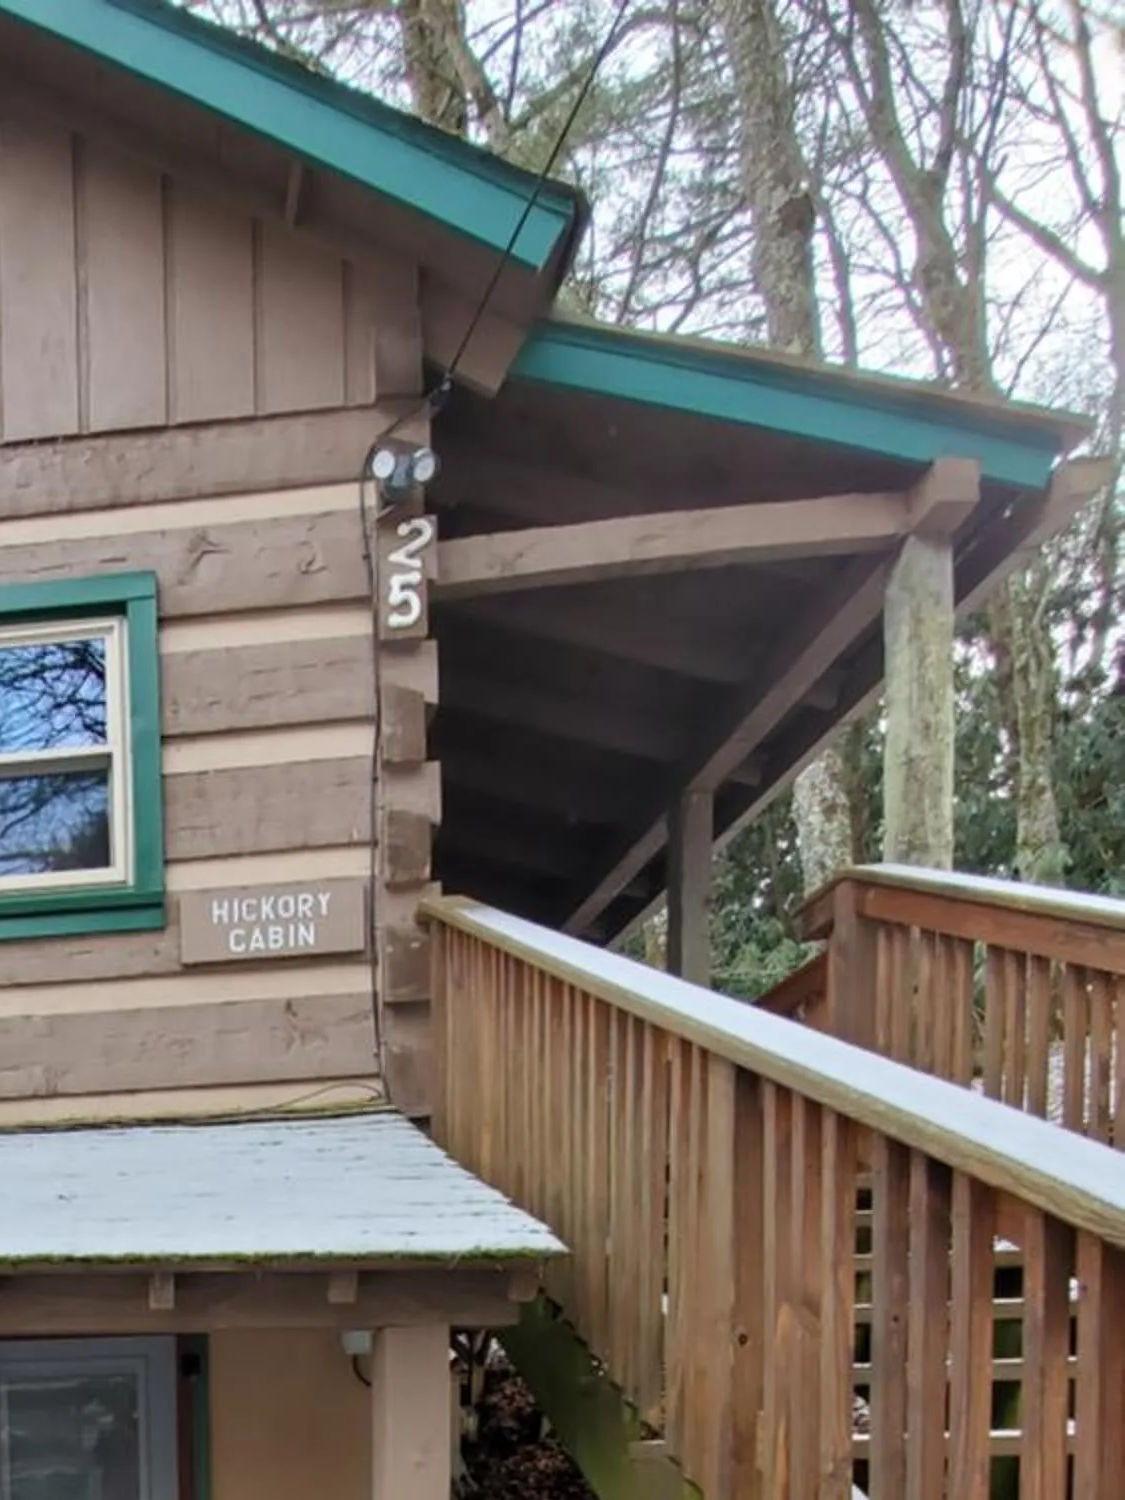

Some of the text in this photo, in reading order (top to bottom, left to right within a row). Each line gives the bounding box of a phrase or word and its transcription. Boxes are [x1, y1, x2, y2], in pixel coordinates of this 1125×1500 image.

[387, 518, 432, 628] 25
[211, 892, 332, 925] HICKORY
[228, 922, 316, 953] CABIN
